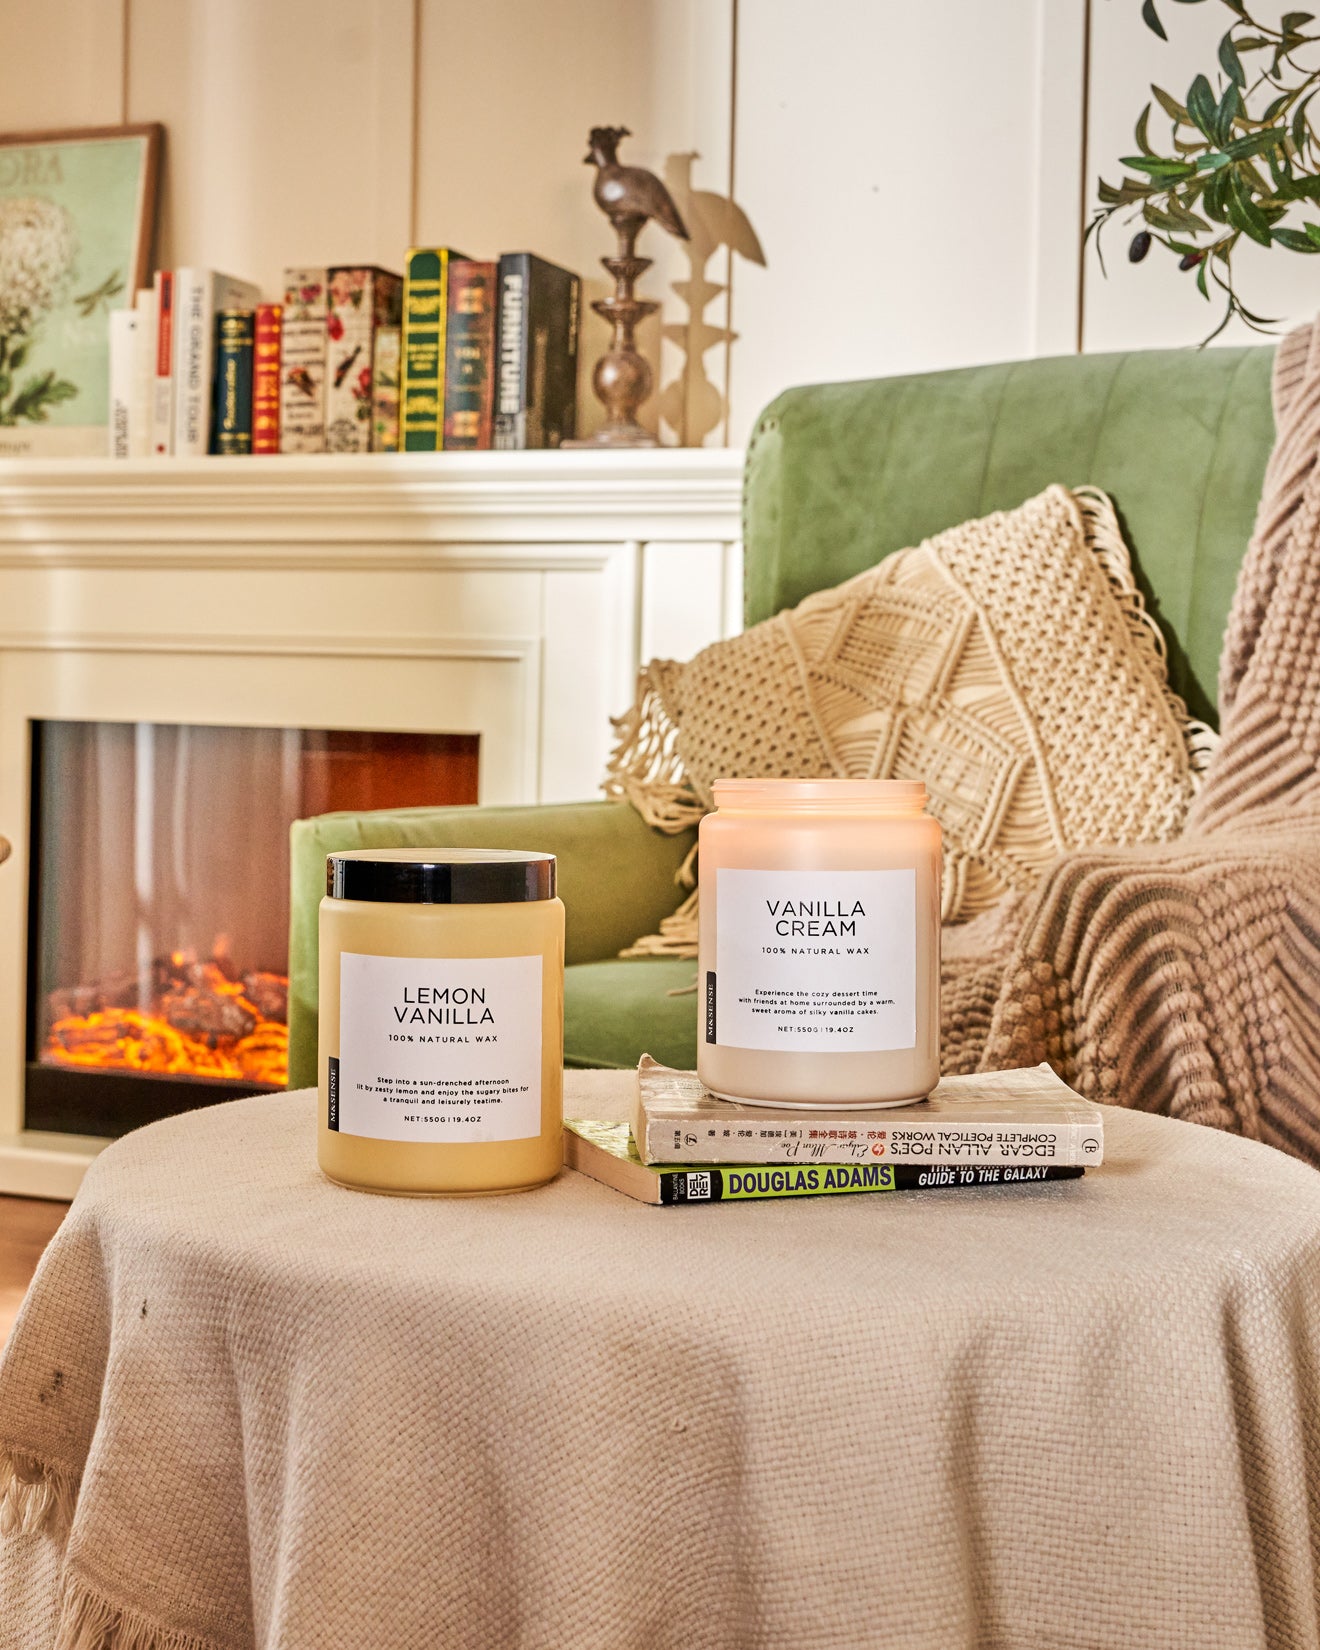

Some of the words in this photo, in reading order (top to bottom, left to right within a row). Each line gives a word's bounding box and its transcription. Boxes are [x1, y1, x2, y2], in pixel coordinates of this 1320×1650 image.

[501, 274, 523, 414] FURNITURE
[766, 900, 866, 917] VANILLA
[775, 920, 856, 937] CREAM
[404, 987, 486, 1004] LEMON
[754, 989, 794, 997] Experience
[393, 1007, 495, 1025] VANILLA
[809, 1008, 827, 1016] silky
[377, 1077, 394, 1085] Step
[365, 1084, 373, 1092] by
[437, 1089, 460, 1097] enjoy
[476, 1088, 501, 1097] sugary
[438, 1098, 472, 1106] leisurely
[892, 1132, 936, 1140] WORKS
[938, 1132, 993, 1142] POETICAL
[996, 1134, 1056, 1142] COMPLETE
[780, 1143, 800, 1157] Poe
[890, 1142, 932, 1155] POE'S
[938, 1143, 991, 1156] ALLAN
[1000, 1144, 1056, 1156] EDGAR
[730, 1170, 819, 1194] DOUGLAS
[824, 1165, 892, 1189] ADAMS
[918, 1172, 956, 1186] GUIDE
[960, 1170, 974, 1182] TO
[979, 1170, 1000, 1182] THE
[1004, 1167, 1048, 1180] GALAXY
[690, 1174, 698, 1198] DEL
[699, 1174, 709, 1196] REY
